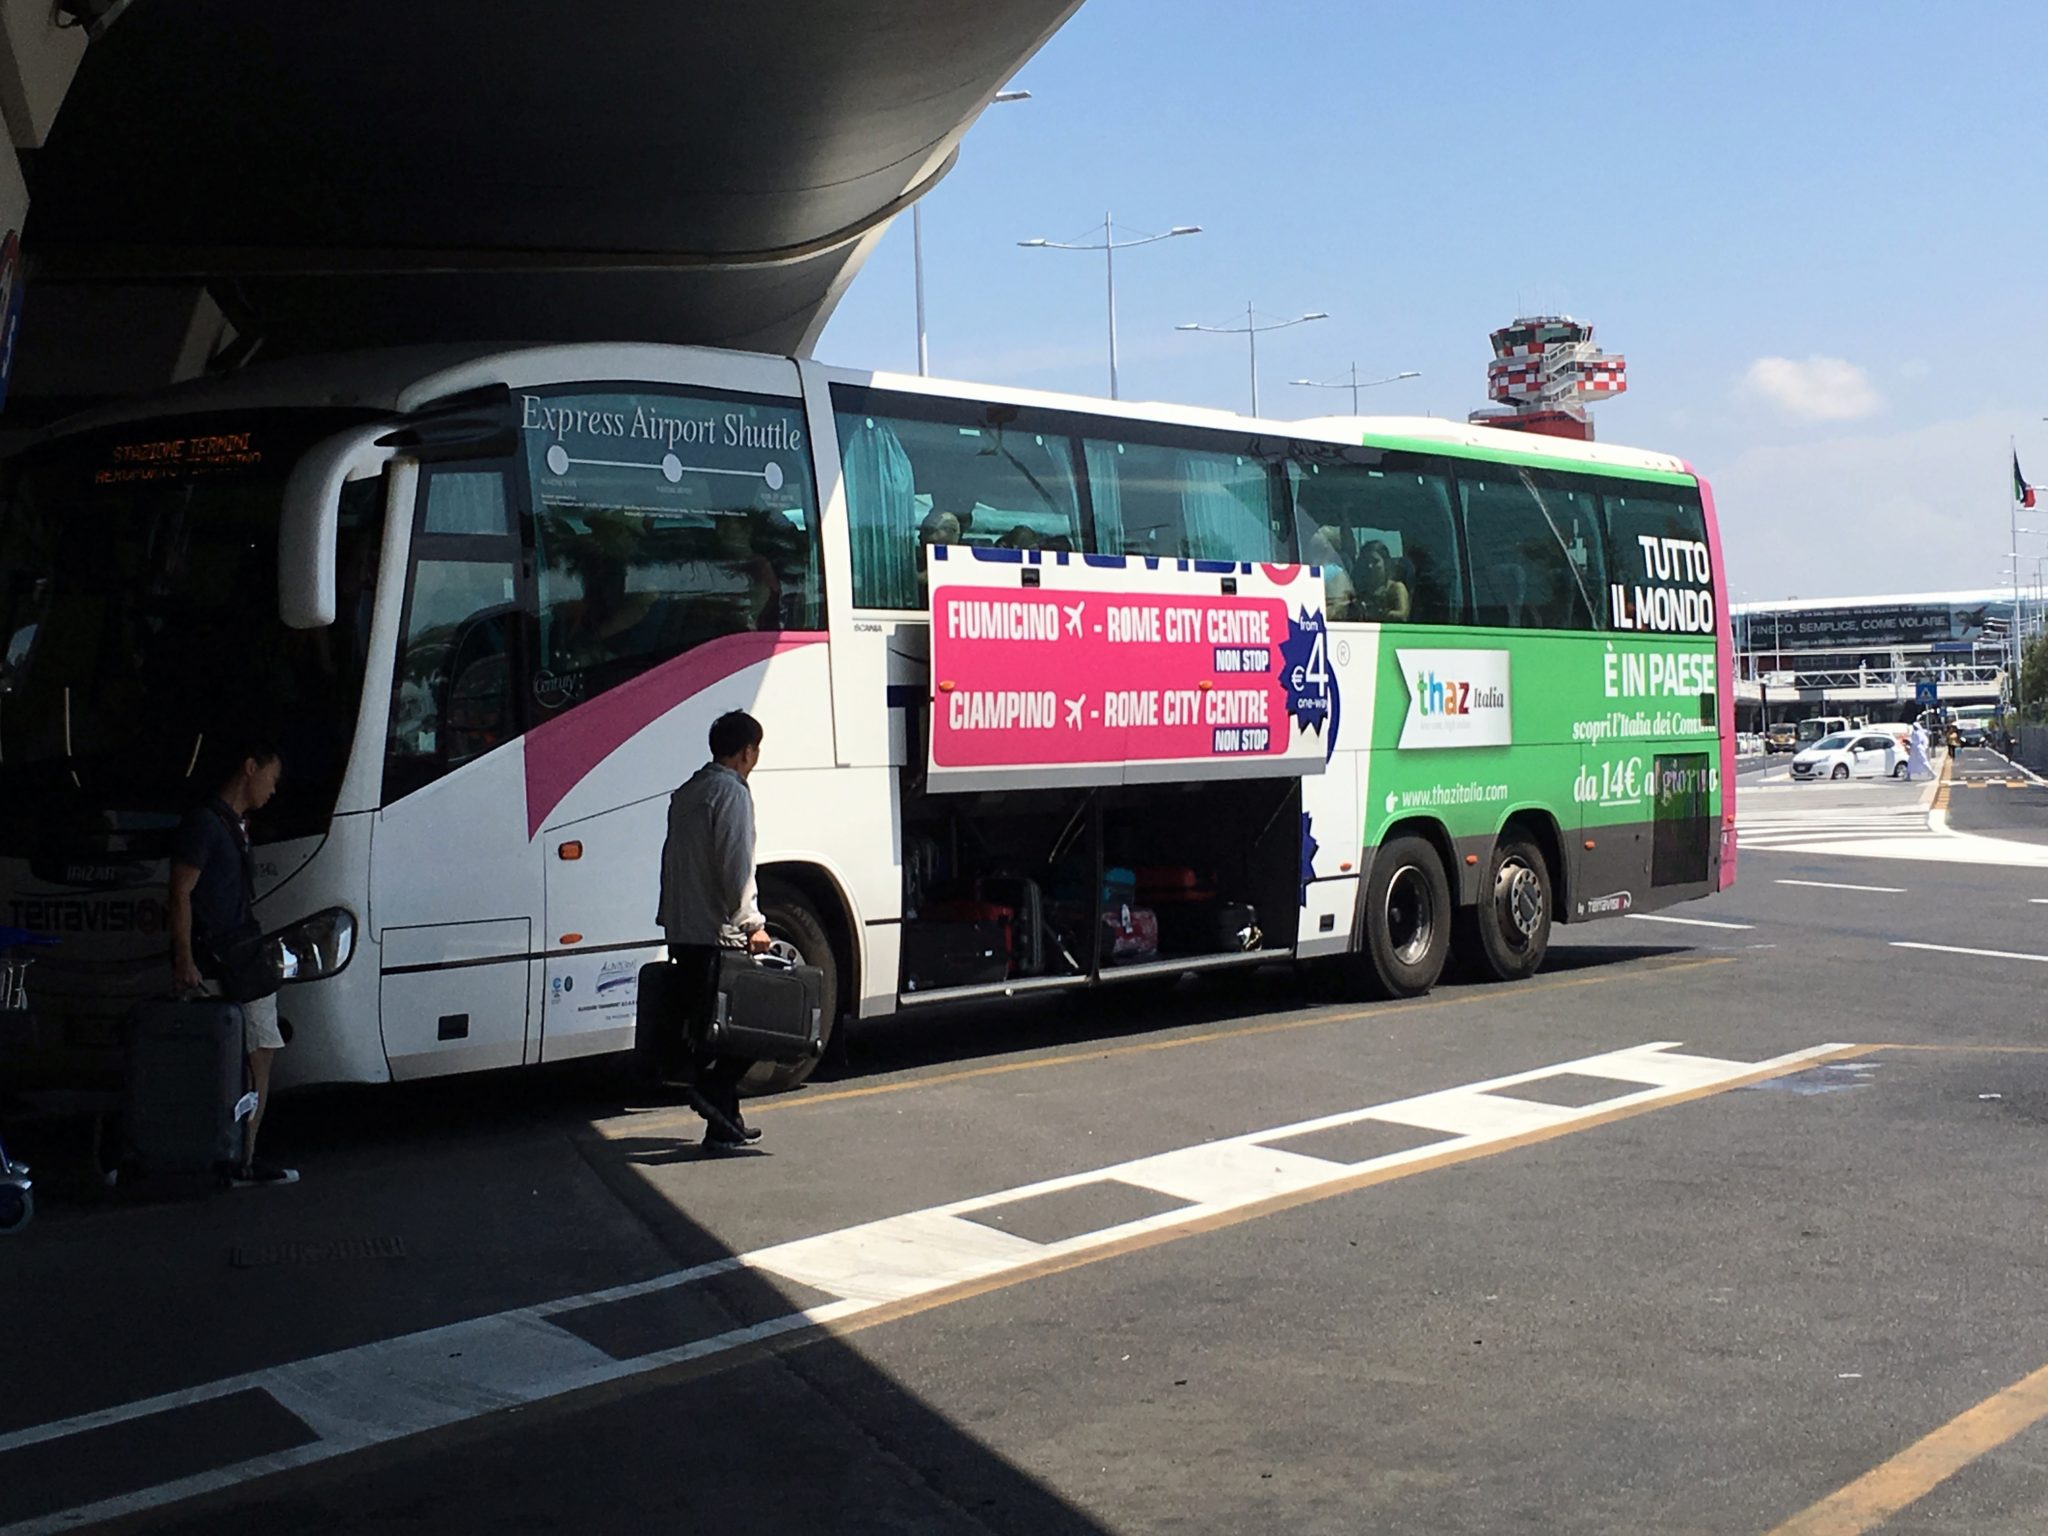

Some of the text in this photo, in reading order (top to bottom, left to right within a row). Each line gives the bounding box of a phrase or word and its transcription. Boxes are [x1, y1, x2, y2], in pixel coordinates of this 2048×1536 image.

[521, 395, 802, 452] Express Airport Shuttle
[1637, 534, 1711, 585] TUTTO
[947, 600, 1060, 641] FIUMICINO
[1106, 606, 1162, 643] ROME
[1165, 606, 1203, 644] CITY
[1206, 608, 1271, 644] CENTRE
[1300, 616, 1319, 632] from
[1611, 583, 1714, 634] IL MONDO
[1861, 617, 1896, 630] COME
[1215, 649, 1270, 672] NON STOP
[1604, 639, 1716, 698] È IN PAESE
[949, 690, 1057, 730] CIAMPINO
[1104, 691, 1159, 728] ROME
[1163, 690, 1201, 726] CITY
[1205, 689, 1269, 726] CENTRE
[1417, 670, 1505, 717] thaz Italia
[1214, 728, 1269, 752] NON STOP
[1572, 712, 1612, 747] scopri
[1652, 711, 1672, 736] dei
[1402, 781, 1509, 807] www.thazitalia.com
[1573, 756, 1718, 807] da 14€ al giorno
[1577, 902, 1585, 916] by
